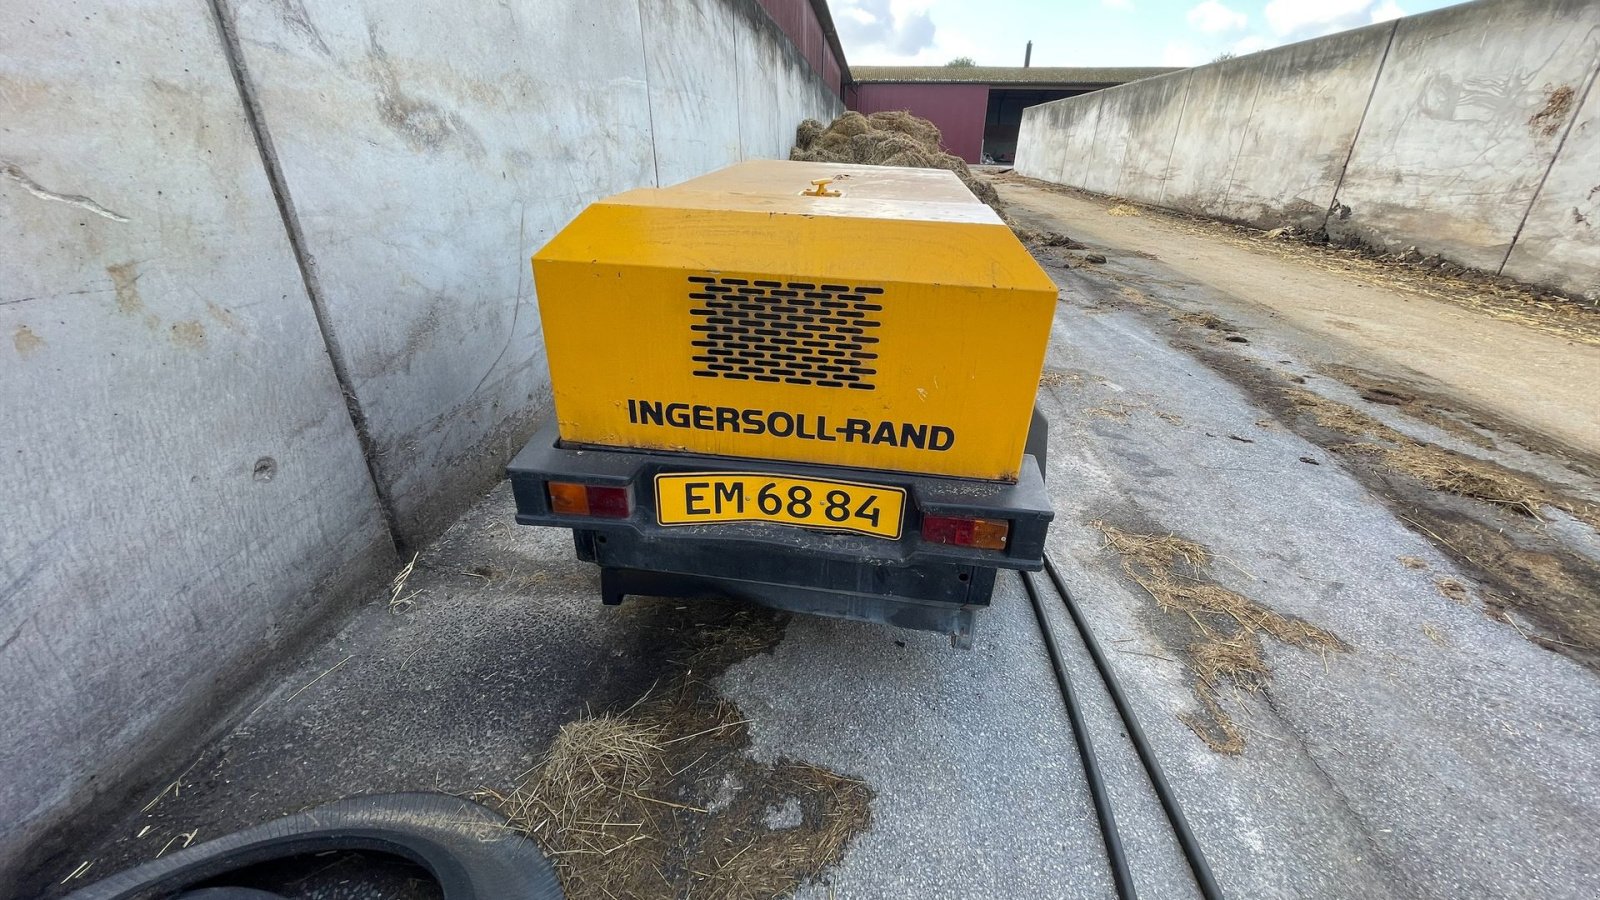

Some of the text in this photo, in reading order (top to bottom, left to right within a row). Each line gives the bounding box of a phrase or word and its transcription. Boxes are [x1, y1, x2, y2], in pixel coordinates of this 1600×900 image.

[628, 399, 955, 451] INGERSOLL-RAND
[685, 482, 880, 527] EM 68 84
